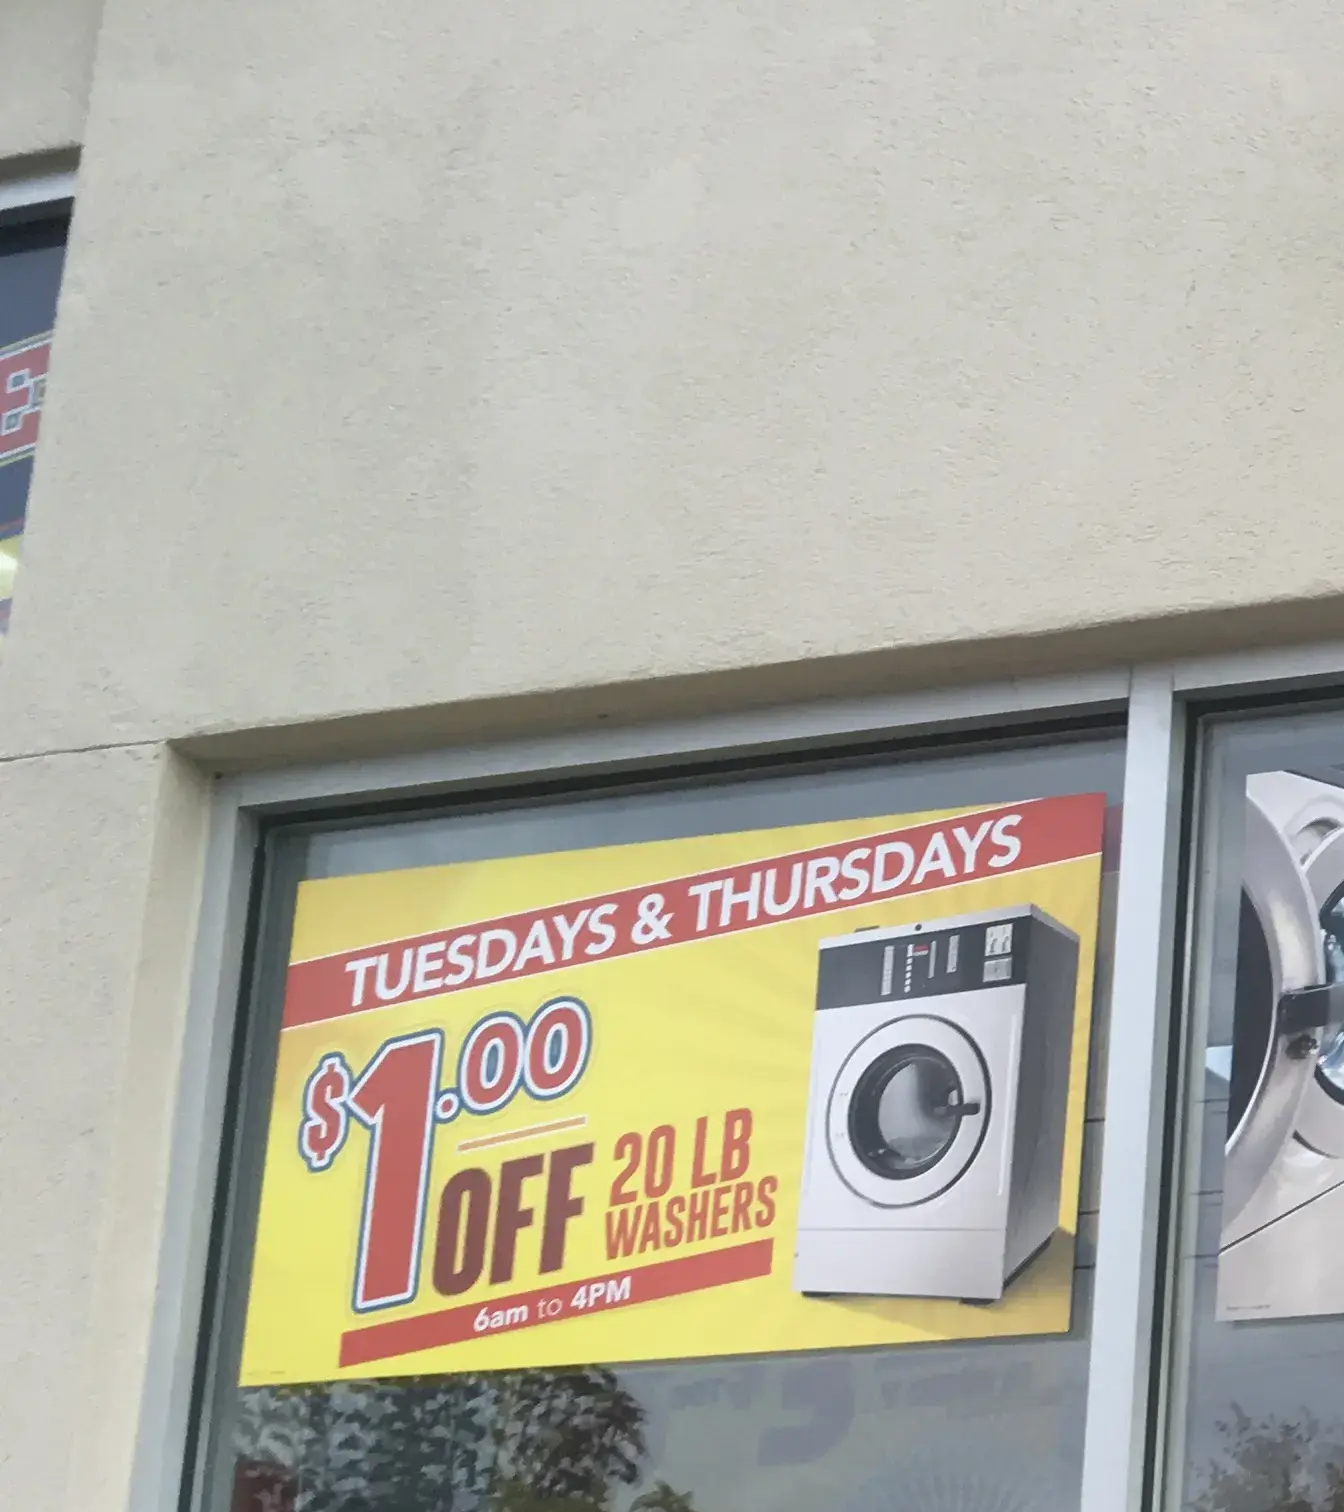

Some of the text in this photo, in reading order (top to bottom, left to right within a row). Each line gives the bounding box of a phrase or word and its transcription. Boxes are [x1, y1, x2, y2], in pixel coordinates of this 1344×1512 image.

[346, 814, 1024, 1007] TUESDAYS & THURSDAYS
[299, 997, 591, 1314] $1.00
[611, 1108, 753, 1204] 20 LB
[432, 1143, 596, 1297] OFF
[605, 1176, 777, 1261] WASHERS
[474, 1278, 631, 1333] 6am to 4PM
